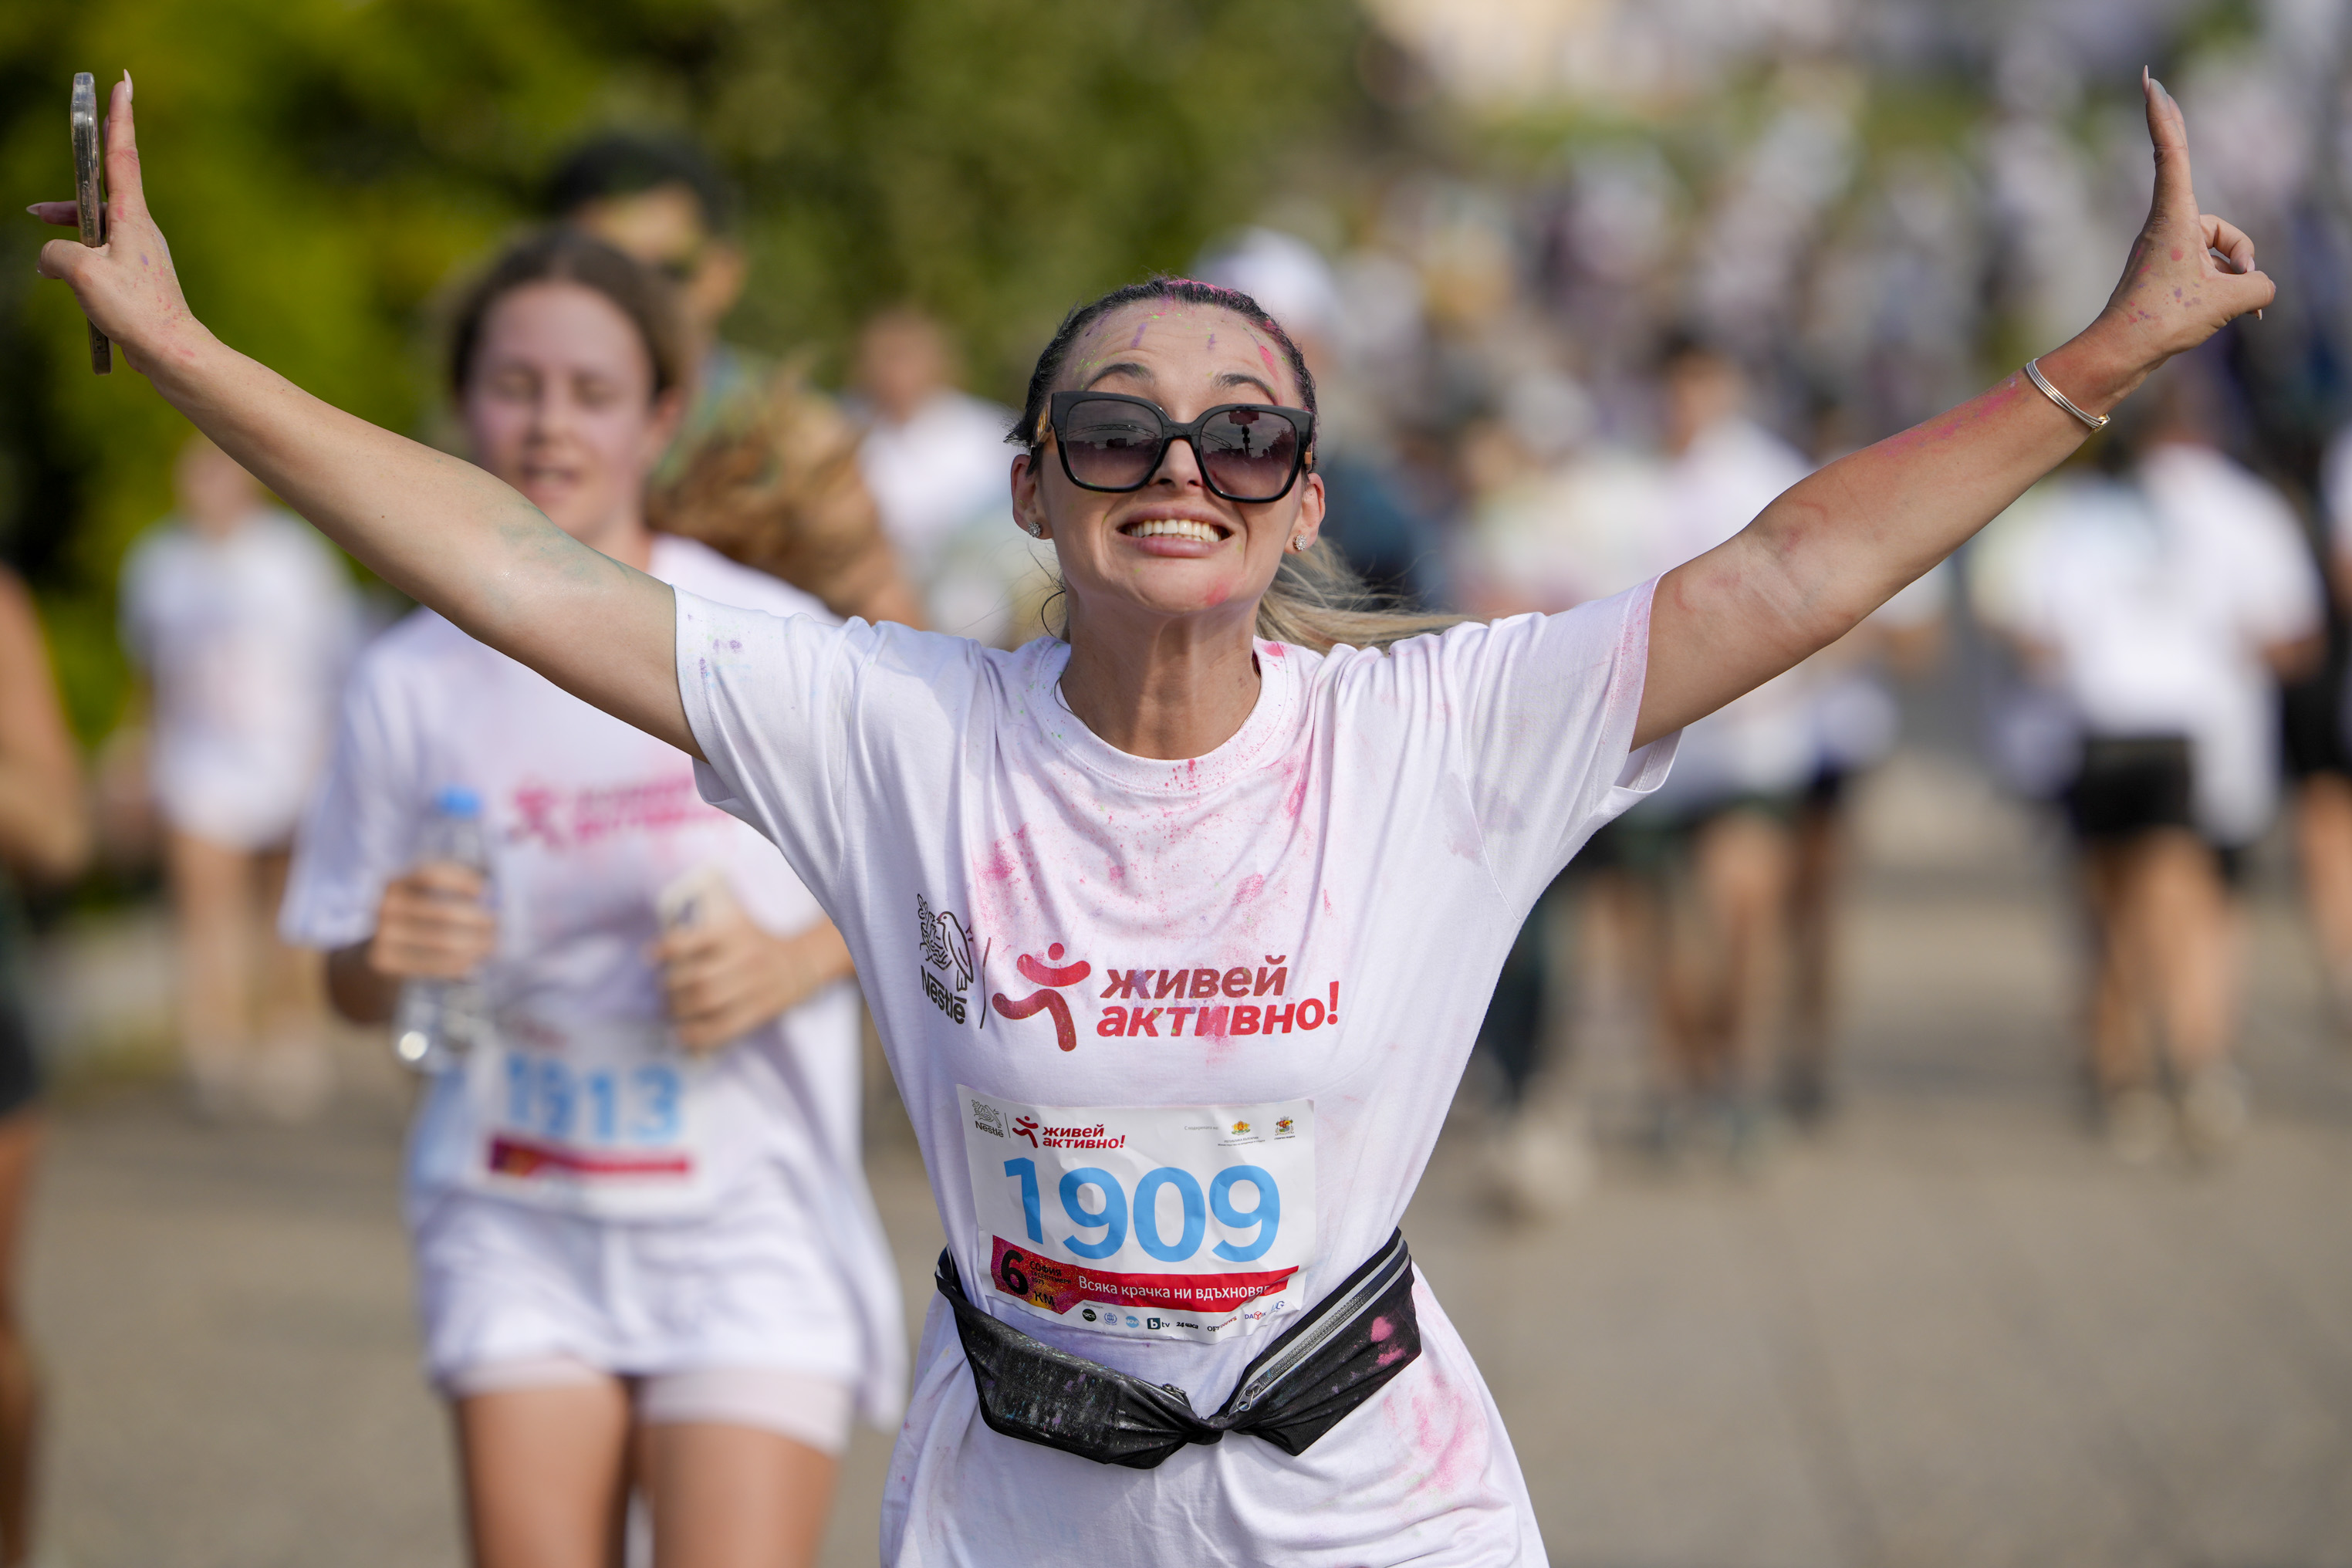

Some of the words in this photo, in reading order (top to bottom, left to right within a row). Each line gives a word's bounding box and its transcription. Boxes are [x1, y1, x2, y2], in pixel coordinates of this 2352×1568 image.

[1099, 955, 1287, 999] живей
[921, 965, 967, 1025] Nestlé
[1097, 981, 1340, 1037] активно!
[975, 1120, 1004, 1138] Nestlé
[1043, 1124, 1105, 1137] живей
[1043, 1134, 1126, 1149] активно!
[1003, 1157, 1280, 1262] 1909
[1001, 1249, 1029, 1295] 6
[1030, 1261, 1062, 1276] СОФИЯ
[1079, 1276, 1117, 1295] Всяка
[1121, 1286, 1170, 1299] крачка
[1174, 1289, 1191, 1299] ни
